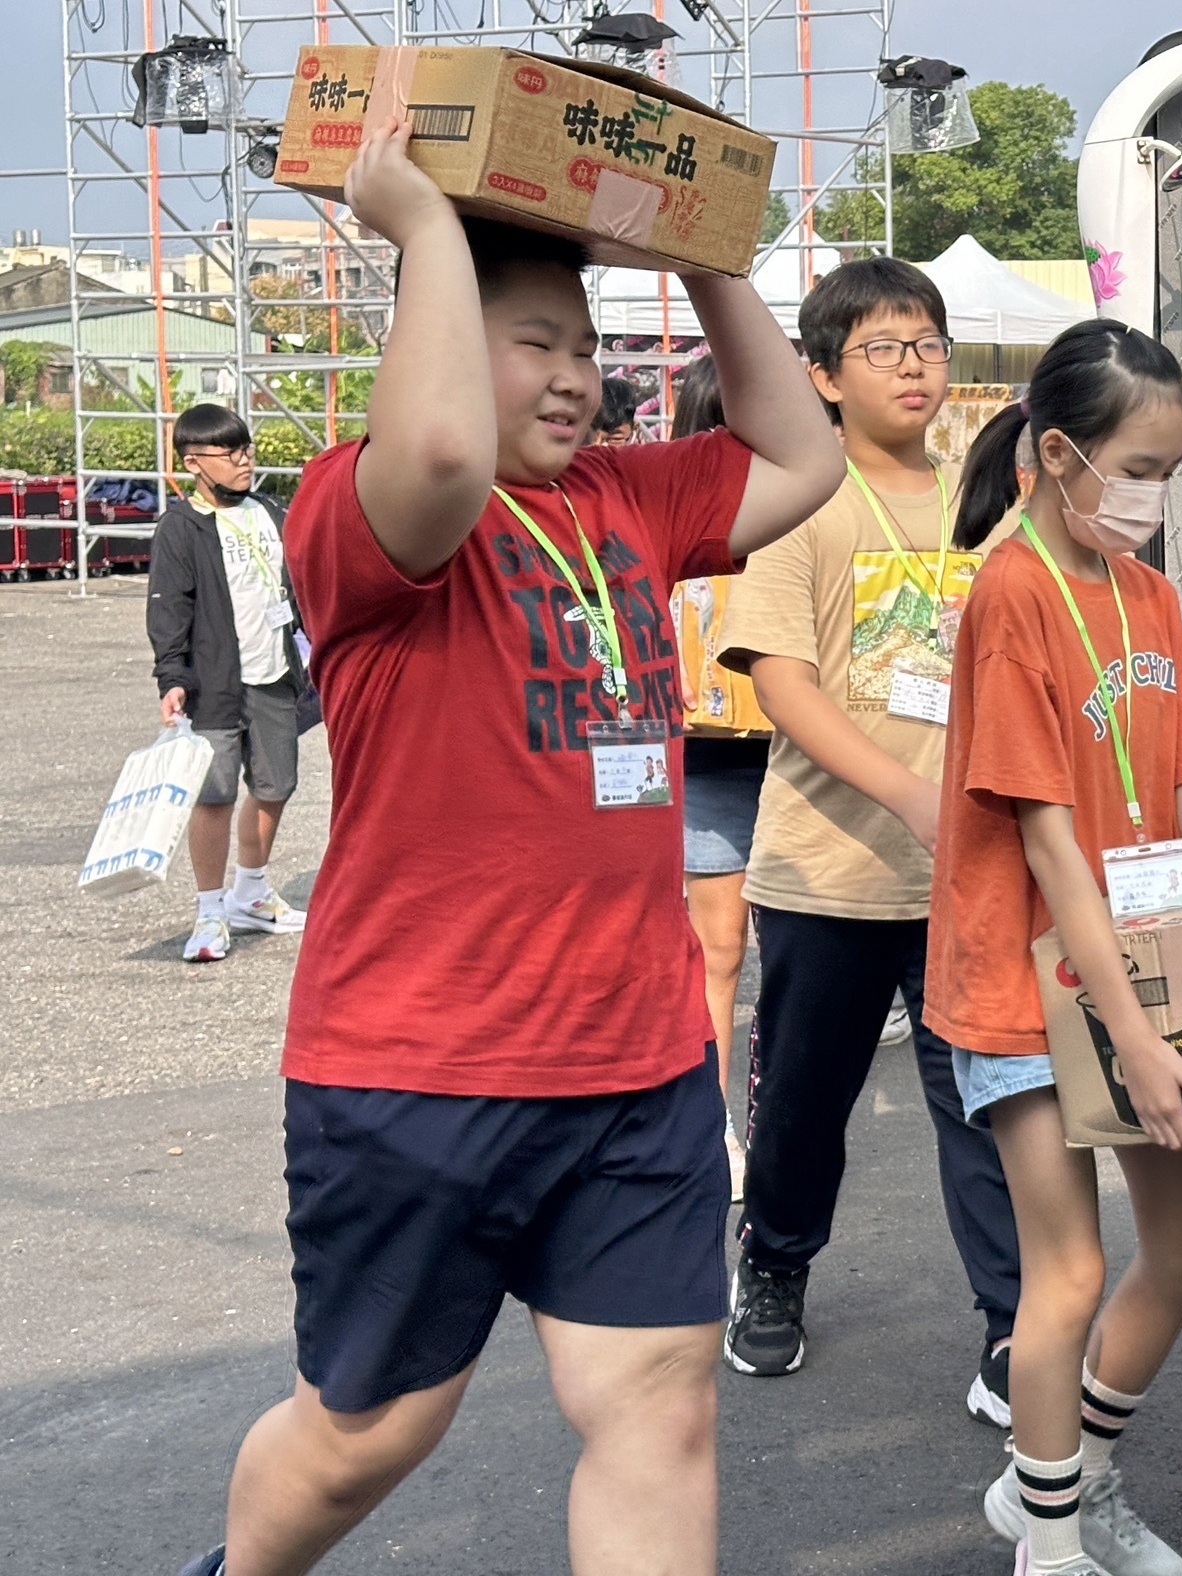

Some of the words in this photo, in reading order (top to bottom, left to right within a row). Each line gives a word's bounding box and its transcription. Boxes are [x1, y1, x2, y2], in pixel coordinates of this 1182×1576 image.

[517, 73, 543, 89] 味丹
[563, 98, 698, 182] 味味一品
[1082, 659, 1127, 741] JUST
